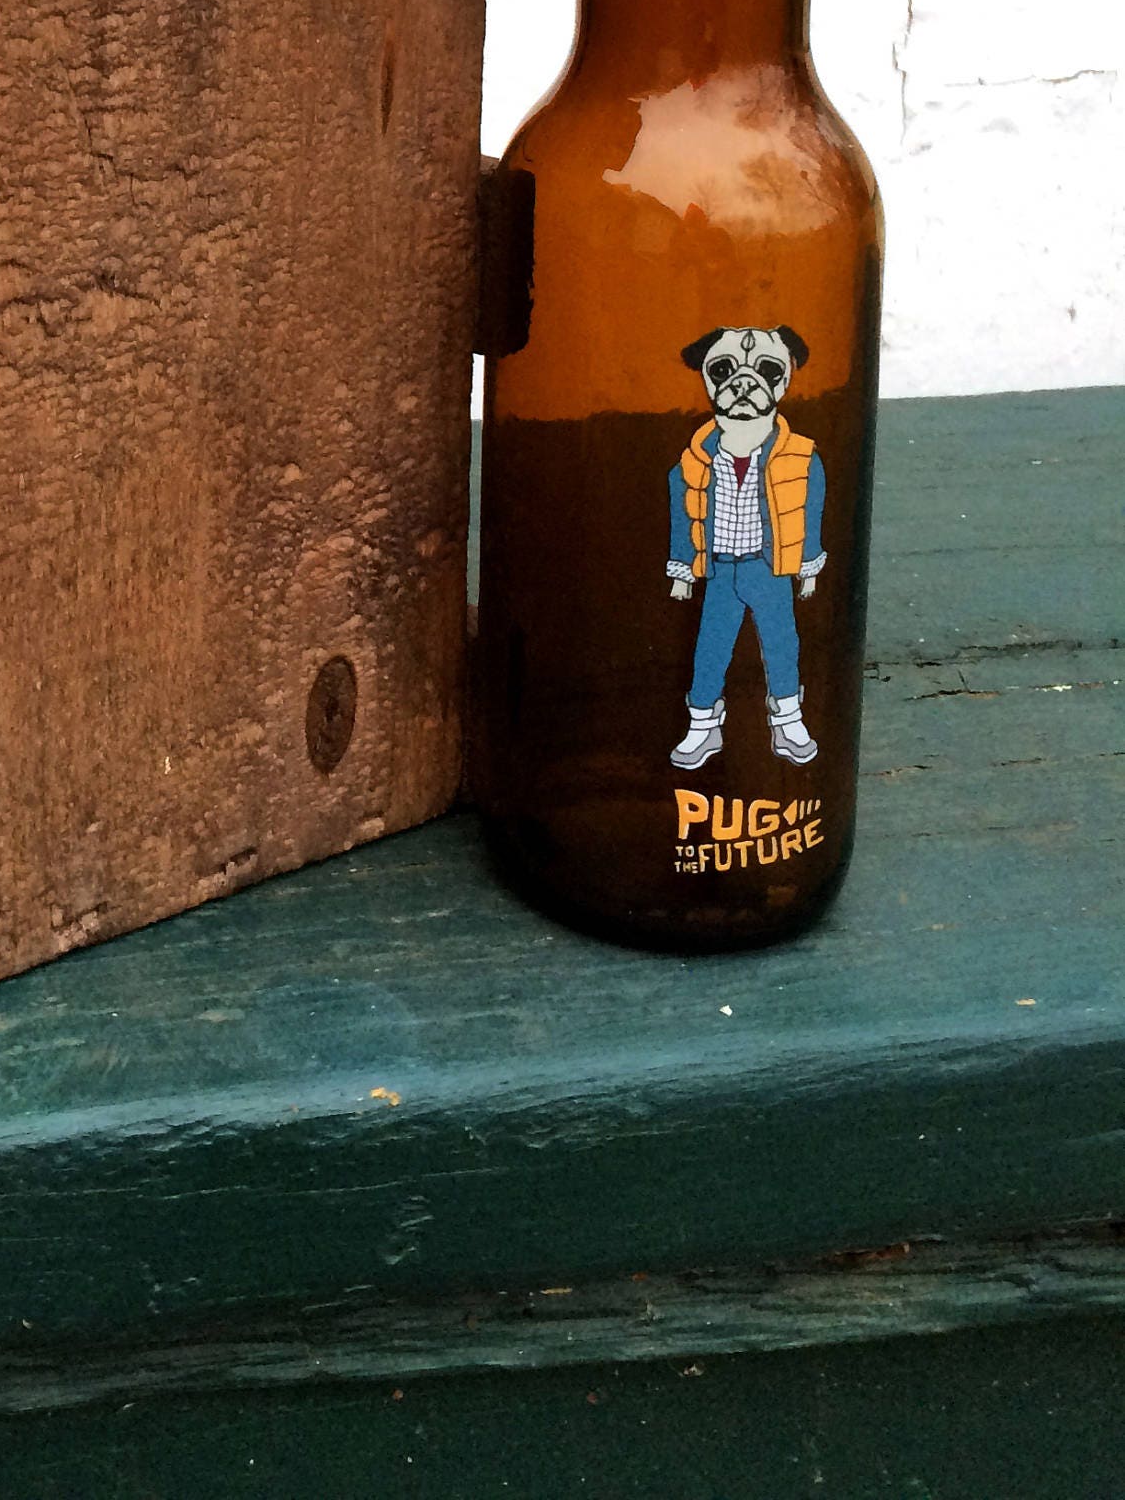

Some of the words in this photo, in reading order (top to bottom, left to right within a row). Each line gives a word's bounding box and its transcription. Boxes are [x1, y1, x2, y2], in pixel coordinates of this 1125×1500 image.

[674, 789, 781, 840] PUG
[676, 845, 695, 857] TO
[698, 818, 824, 872] FUTURE
[674, 861, 699, 873] THE
